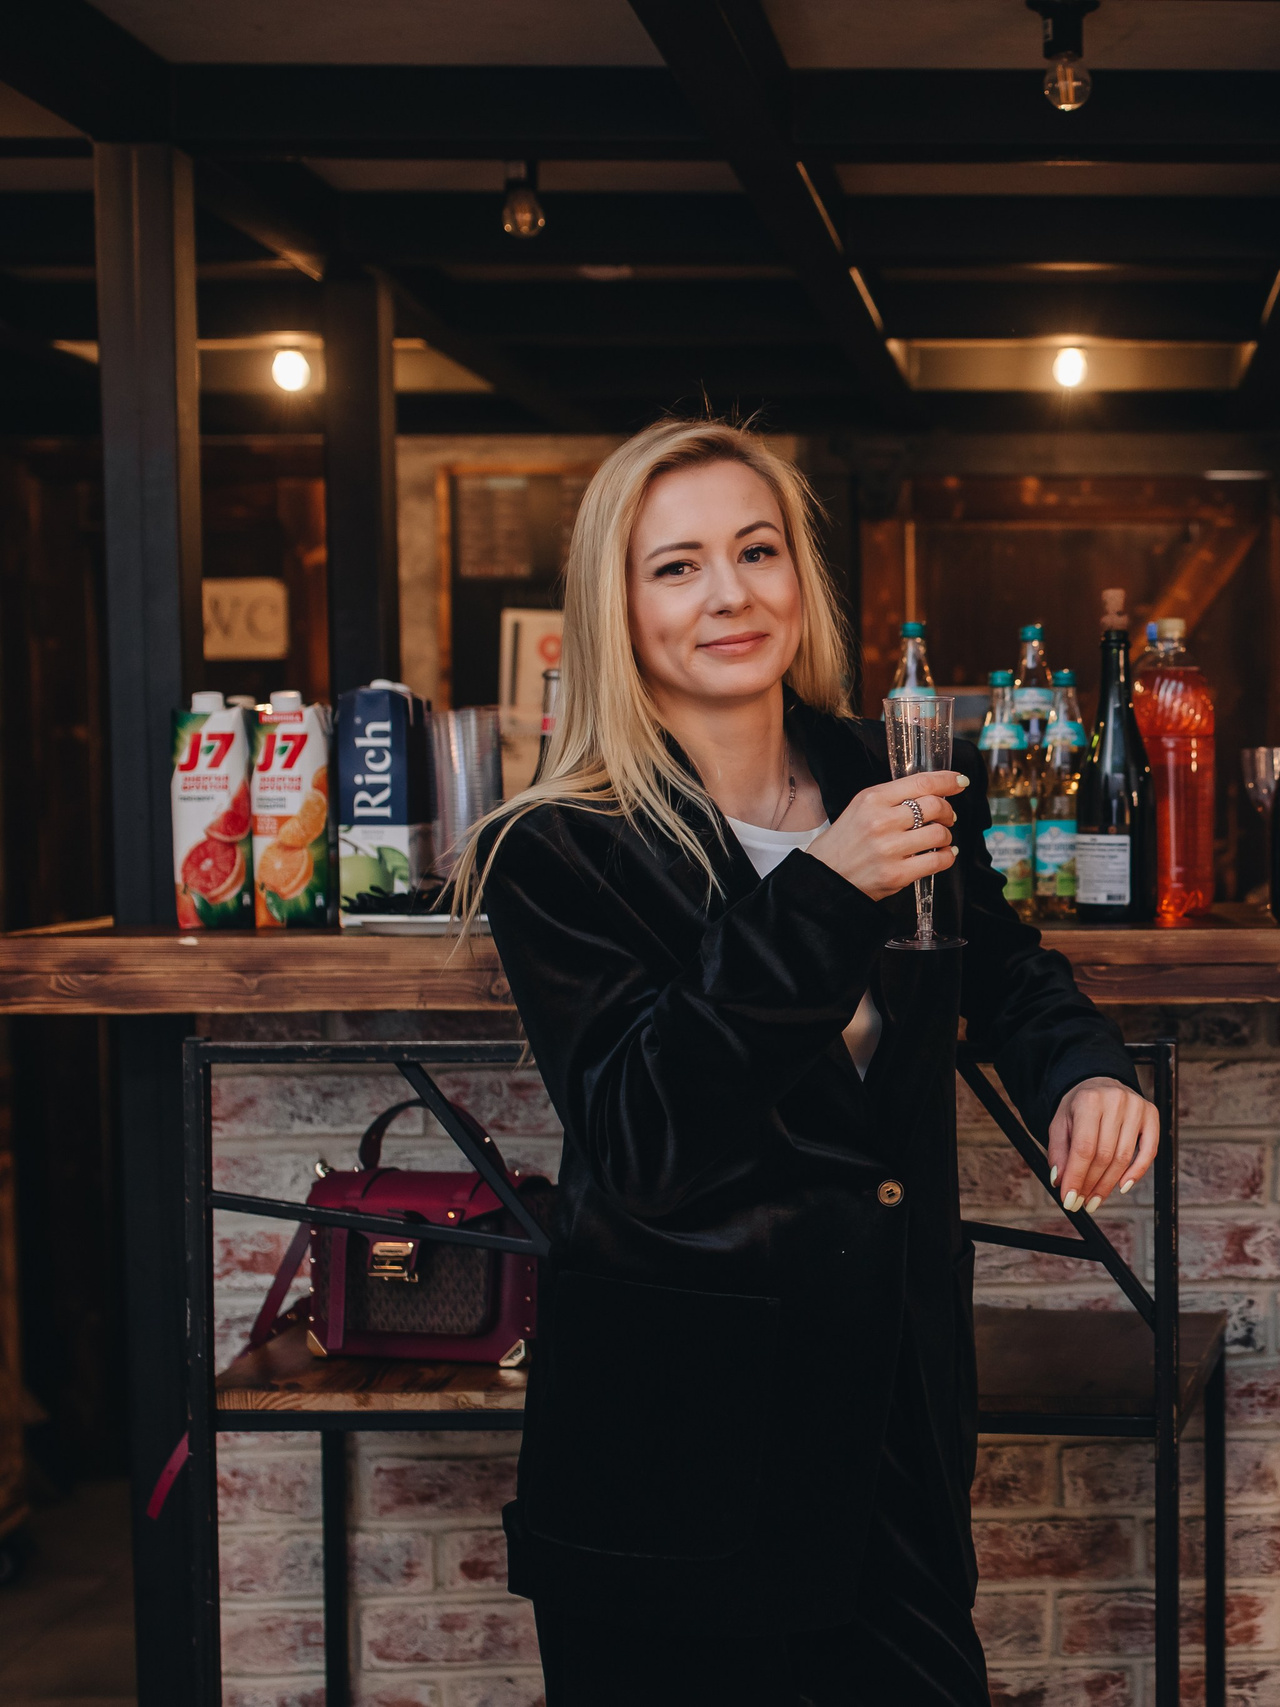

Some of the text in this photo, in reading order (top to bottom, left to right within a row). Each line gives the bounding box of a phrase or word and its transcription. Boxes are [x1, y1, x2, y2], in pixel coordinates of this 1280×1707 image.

[178, 732, 235, 771] J7
[257, 733, 308, 772] J7
[353, 720, 392, 819] Rich
